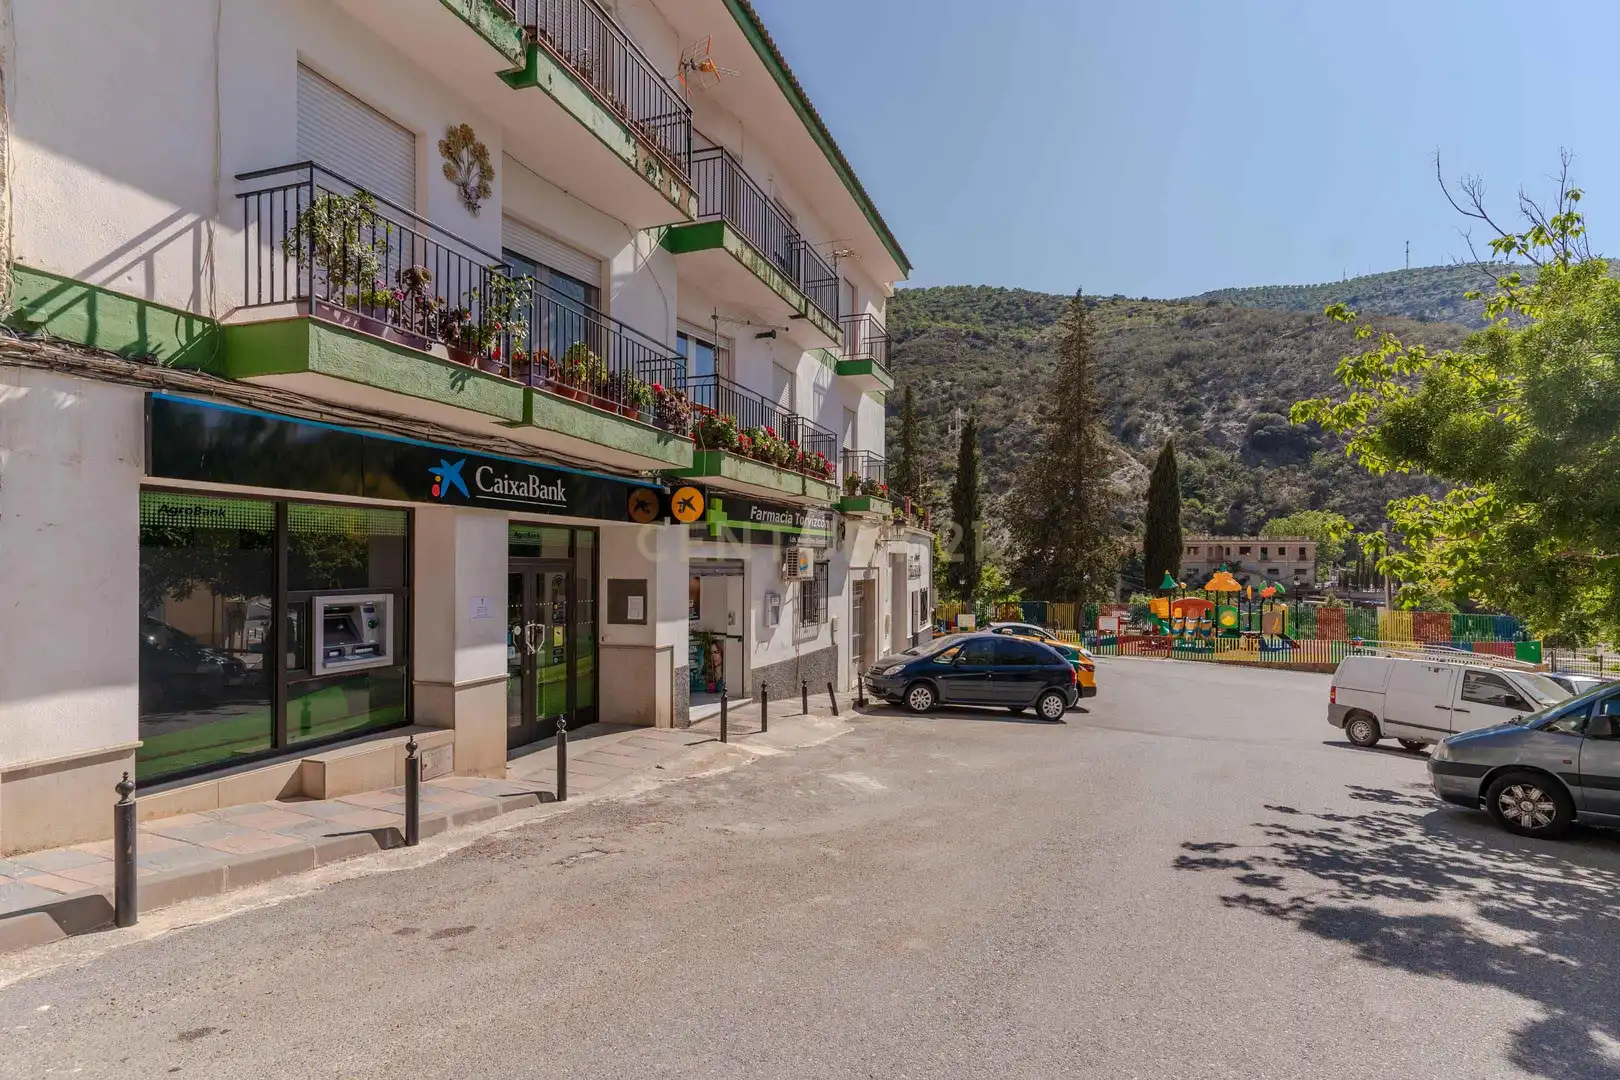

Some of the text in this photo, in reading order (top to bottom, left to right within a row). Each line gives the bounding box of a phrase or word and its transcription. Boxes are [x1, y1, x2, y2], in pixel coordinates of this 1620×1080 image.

[475, 465, 567, 501] CaixaBank
[159, 504, 226, 517] AgroBank
[750, 505, 793, 524] Farmacia
